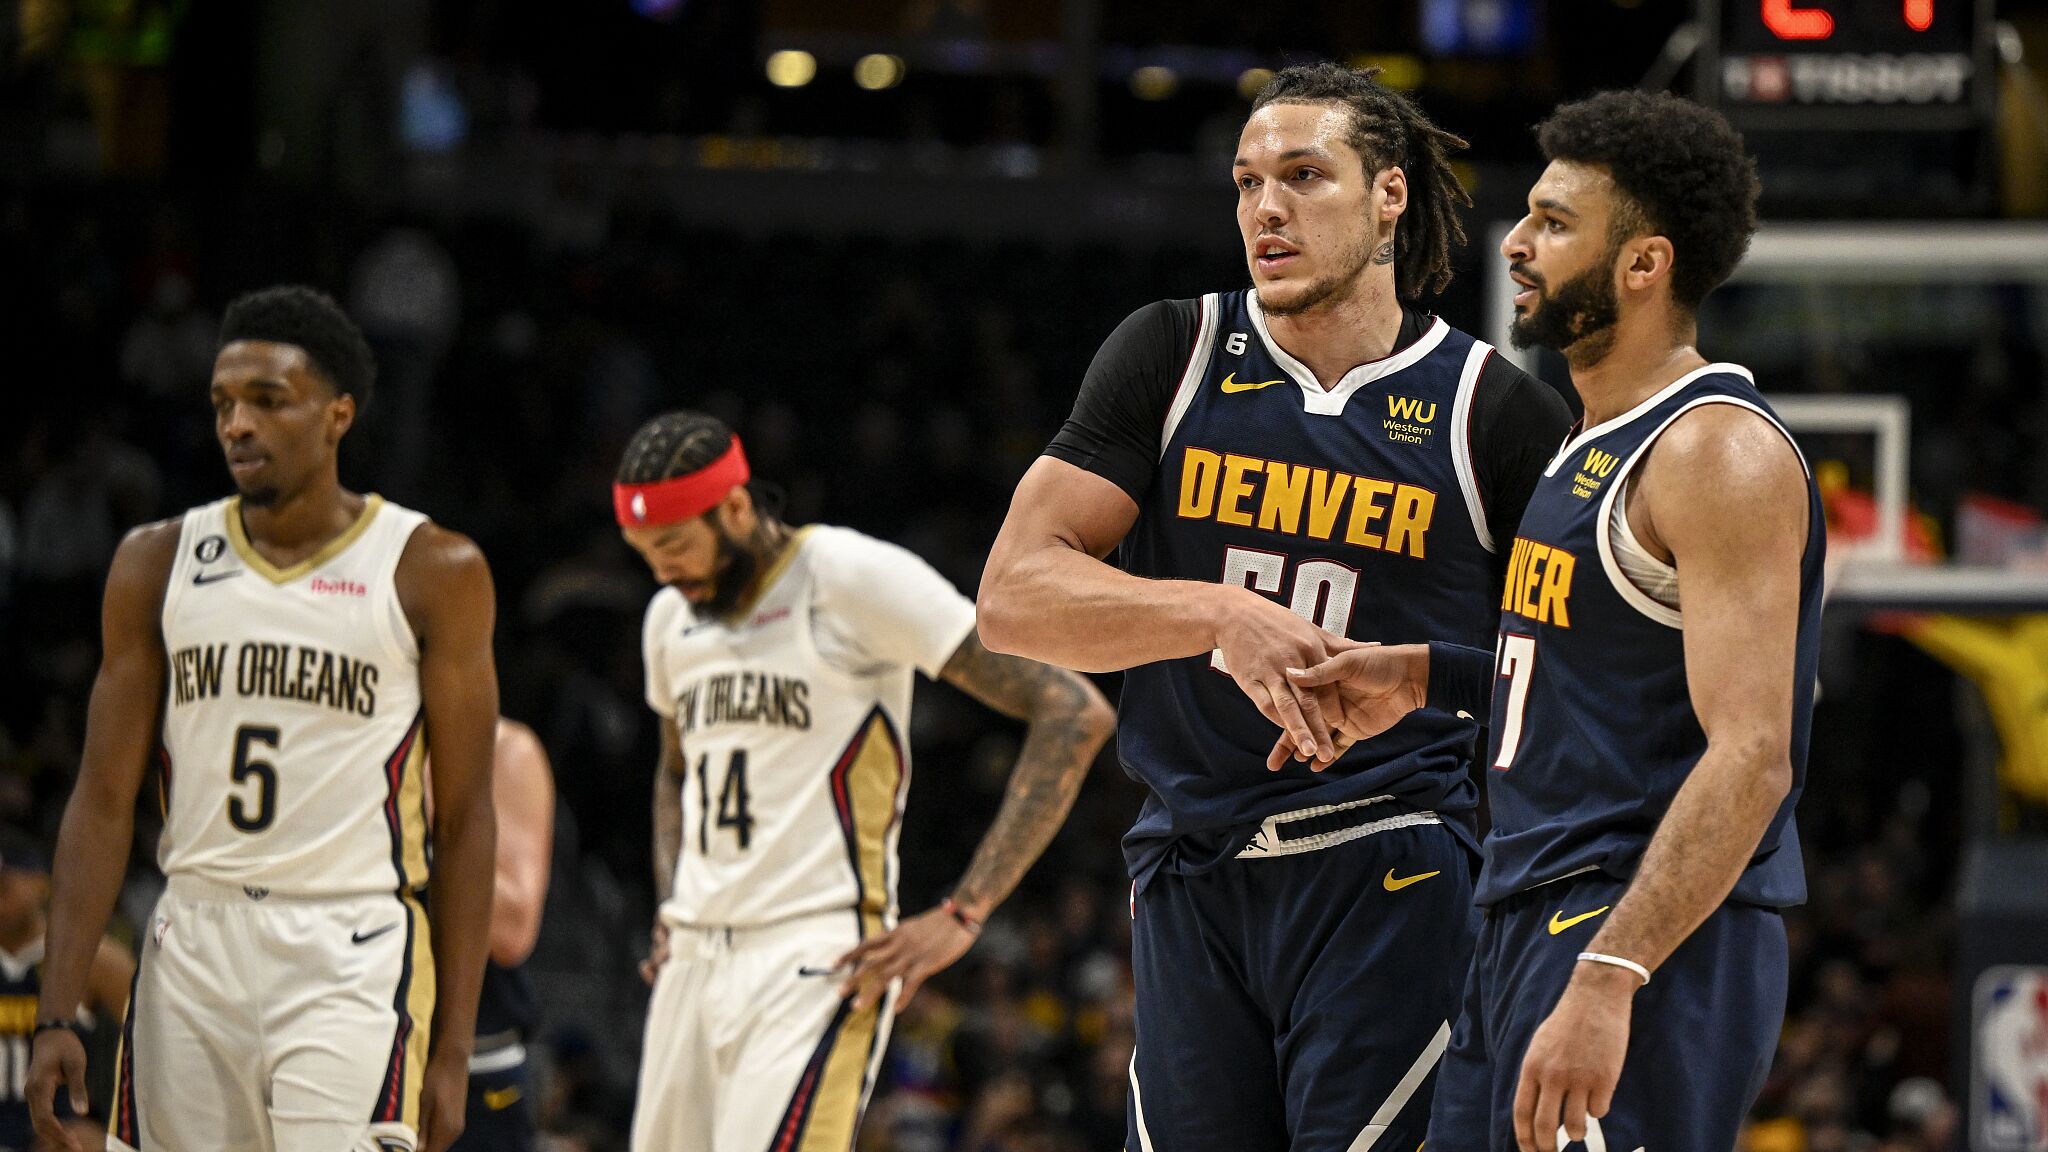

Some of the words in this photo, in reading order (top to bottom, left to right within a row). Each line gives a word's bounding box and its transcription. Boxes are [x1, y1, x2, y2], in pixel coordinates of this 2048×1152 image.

[1225, 332, 1249, 356] 6
[1387, 395, 1437, 424] WU
[1383, 419, 1432, 436] Western
[1388, 430, 1422, 445] Union
[1583, 447, 1620, 478] WU
[1176, 445, 1438, 560] DENVER
[172, 643, 229, 706] NEW
[237, 641, 379, 719] ORLEANS
[226, 721, 281, 834] 5
[697, 746, 755, 855] 14
